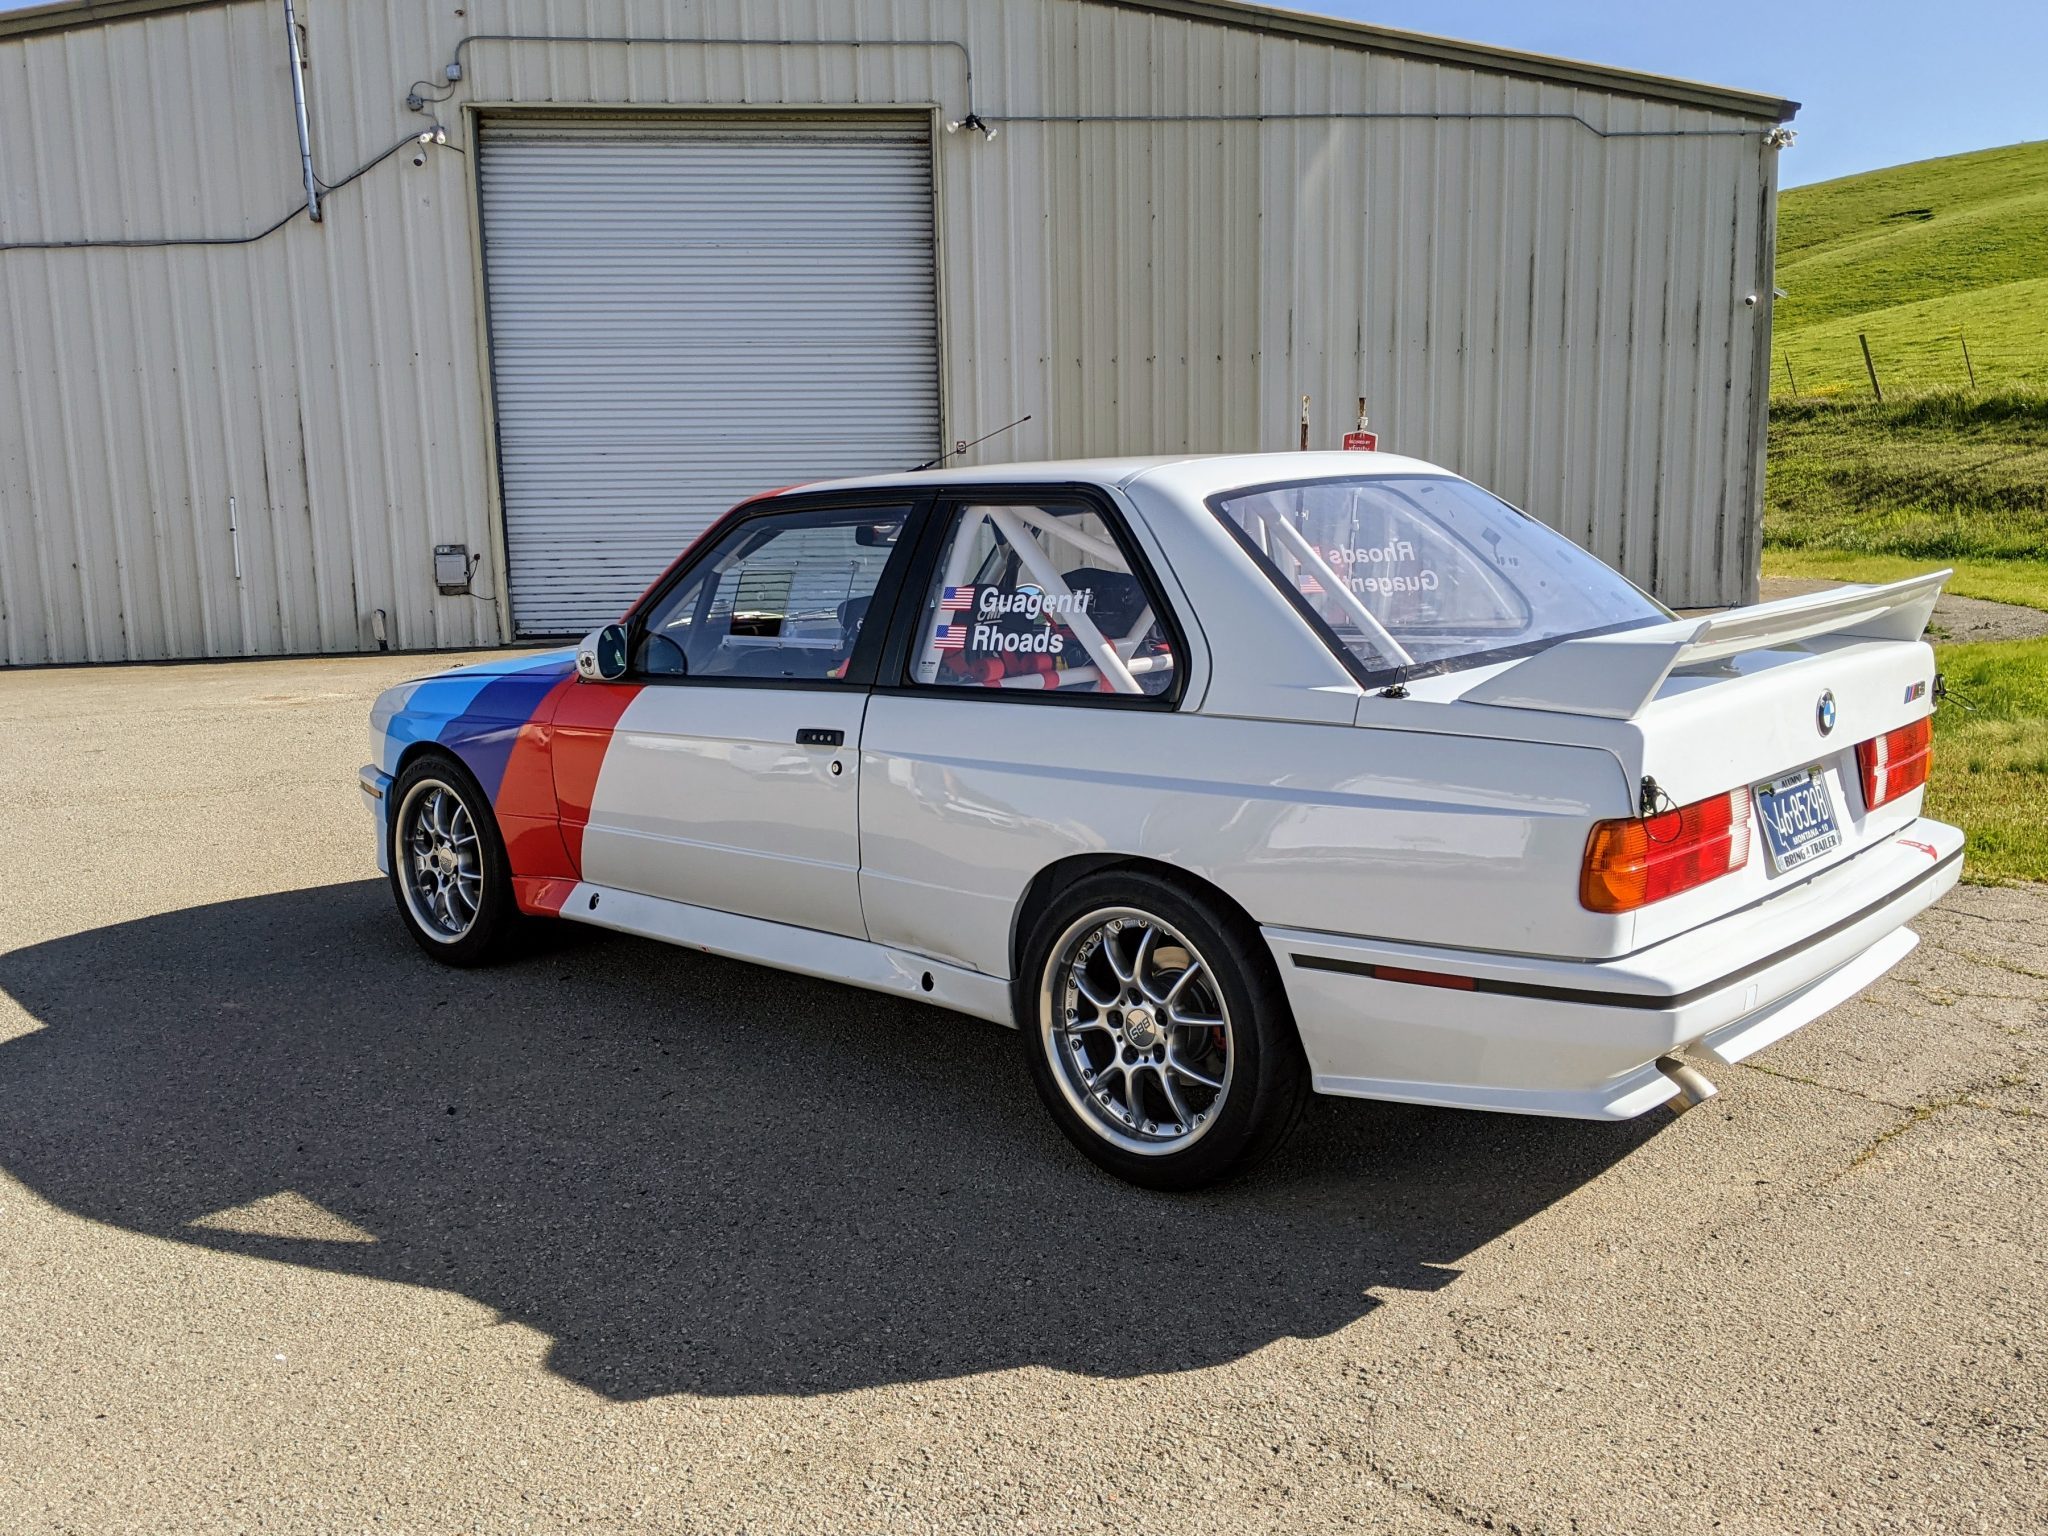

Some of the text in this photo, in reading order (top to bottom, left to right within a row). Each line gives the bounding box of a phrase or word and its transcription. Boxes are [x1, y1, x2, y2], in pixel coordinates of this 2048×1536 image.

[979, 586, 1090, 620] Guagenti
[972, 625, 1064, 653] Rhoads
[1781, 774, 1802, 787] ALUMNI
[1792, 828, 1819, 845] MONTANA
[1784, 851, 1806, 867] BRING
[1809, 835, 1837, 855] TRAILER
